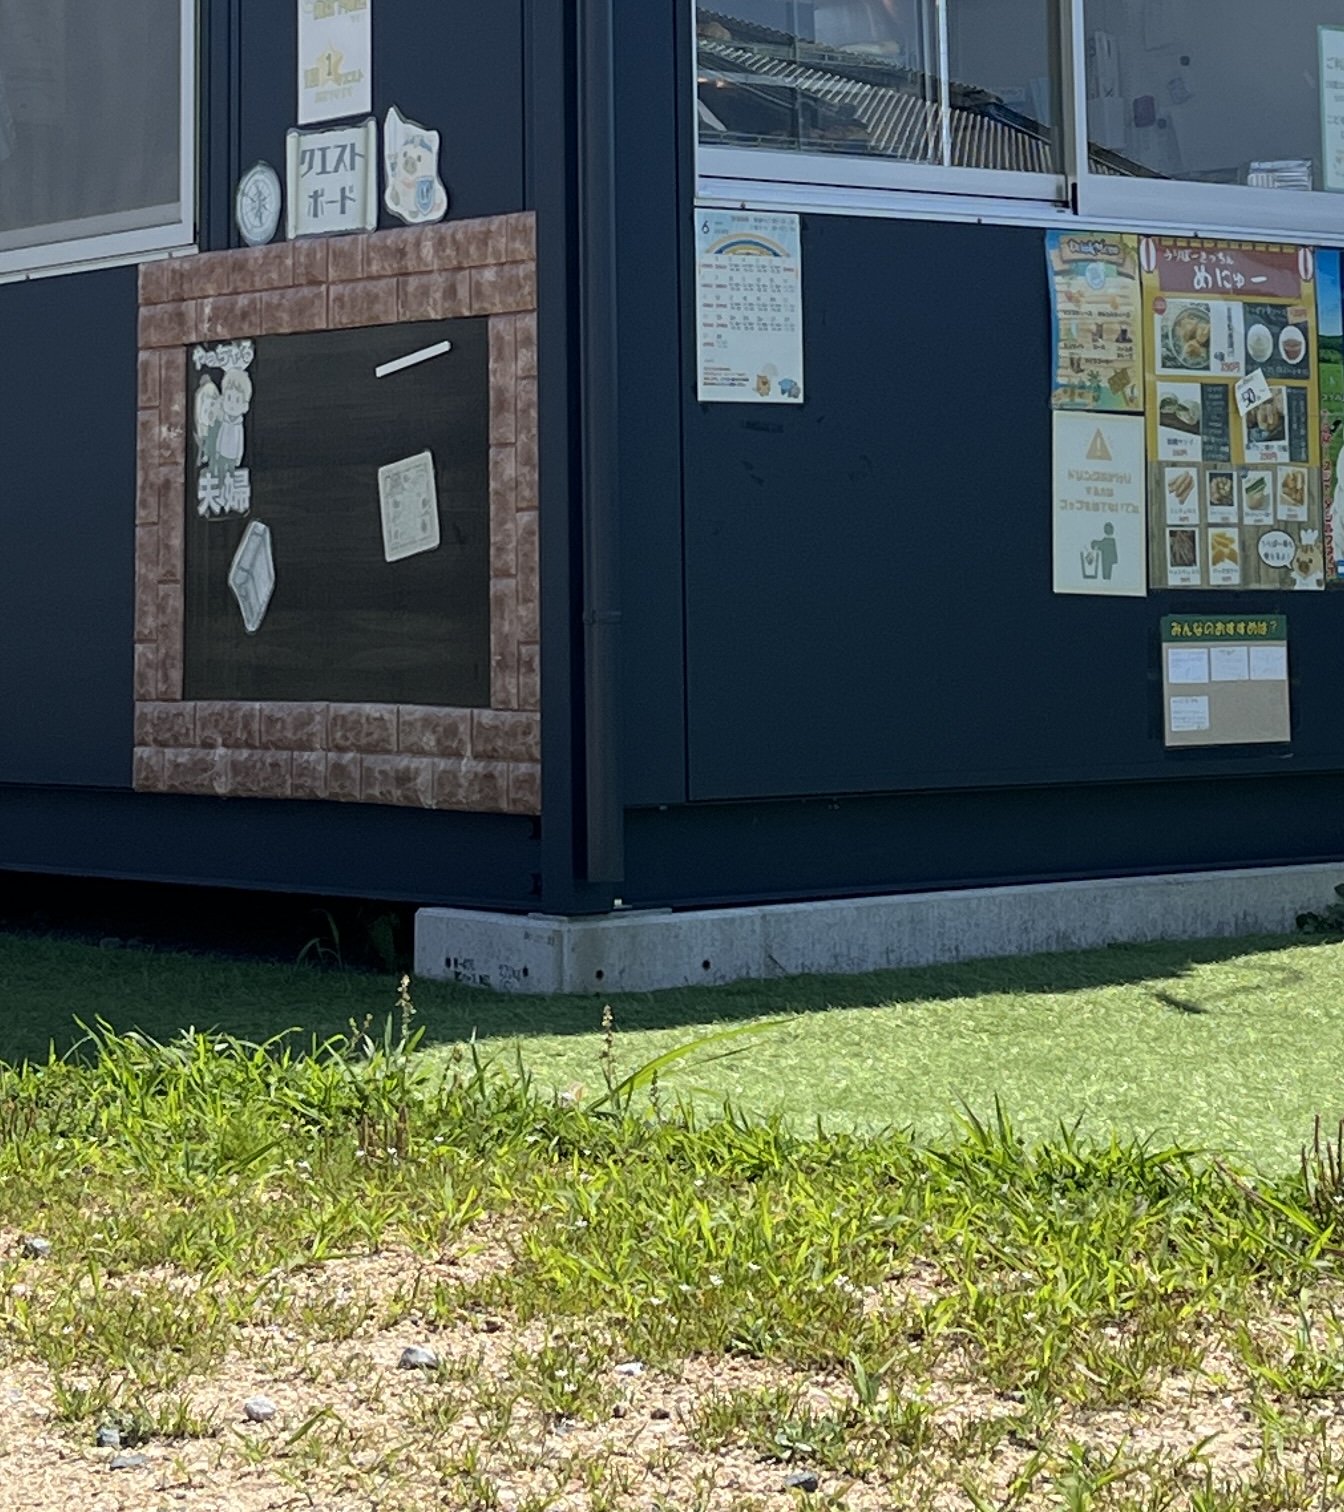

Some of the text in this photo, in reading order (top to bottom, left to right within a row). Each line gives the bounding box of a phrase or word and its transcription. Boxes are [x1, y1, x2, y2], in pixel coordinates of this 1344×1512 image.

[299, 142, 366, 178] クエスト
[307, 185, 358, 220] ボード
[701, 219, 710, 235] 6
[1163, 248, 1235, 265] うりぼーきっちん
[1193, 264, 1268, 289] めにゅー
[197, 468, 251, 518] 夫婦
[1171, 620, 1278, 637] みんなのおすすめは？
